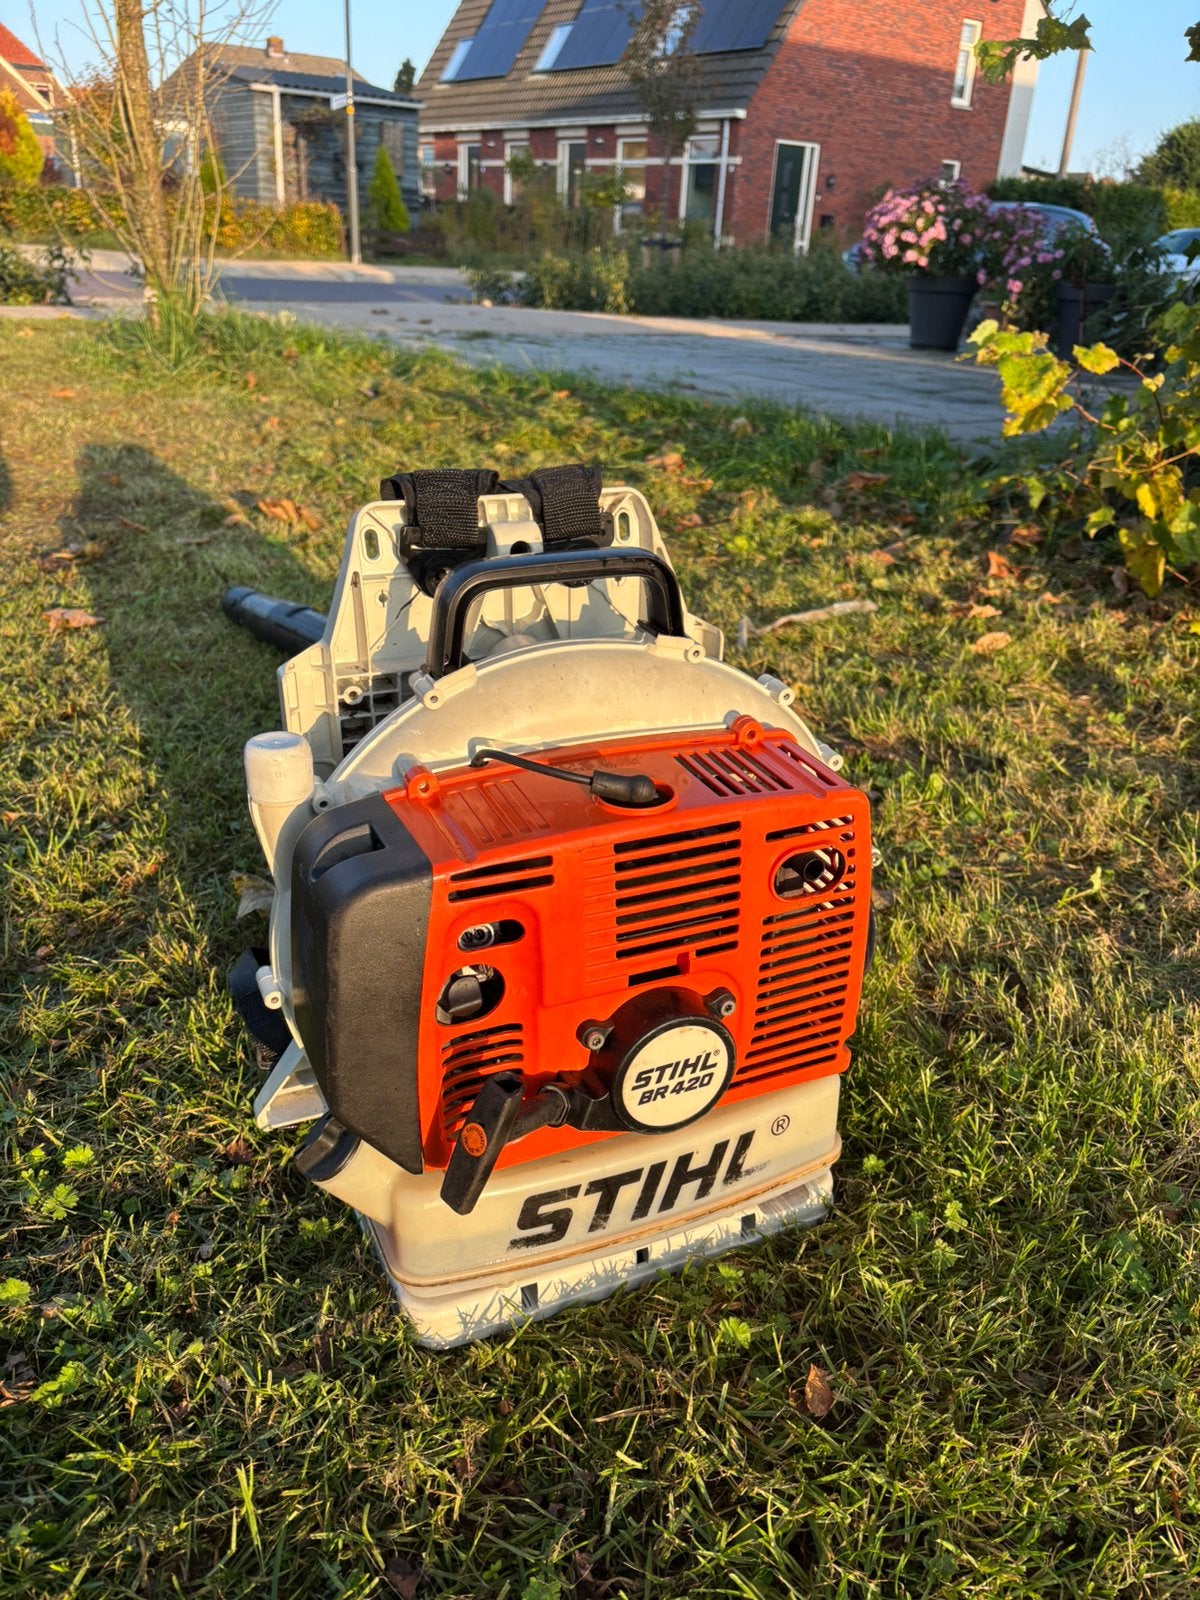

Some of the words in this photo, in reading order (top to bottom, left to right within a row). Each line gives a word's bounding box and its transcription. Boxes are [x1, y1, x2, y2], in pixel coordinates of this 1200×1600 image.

[638, 1085, 669, 1105] BR
[670, 1072, 714, 1095] 420
[508, 1130, 771, 1250] STIHL
